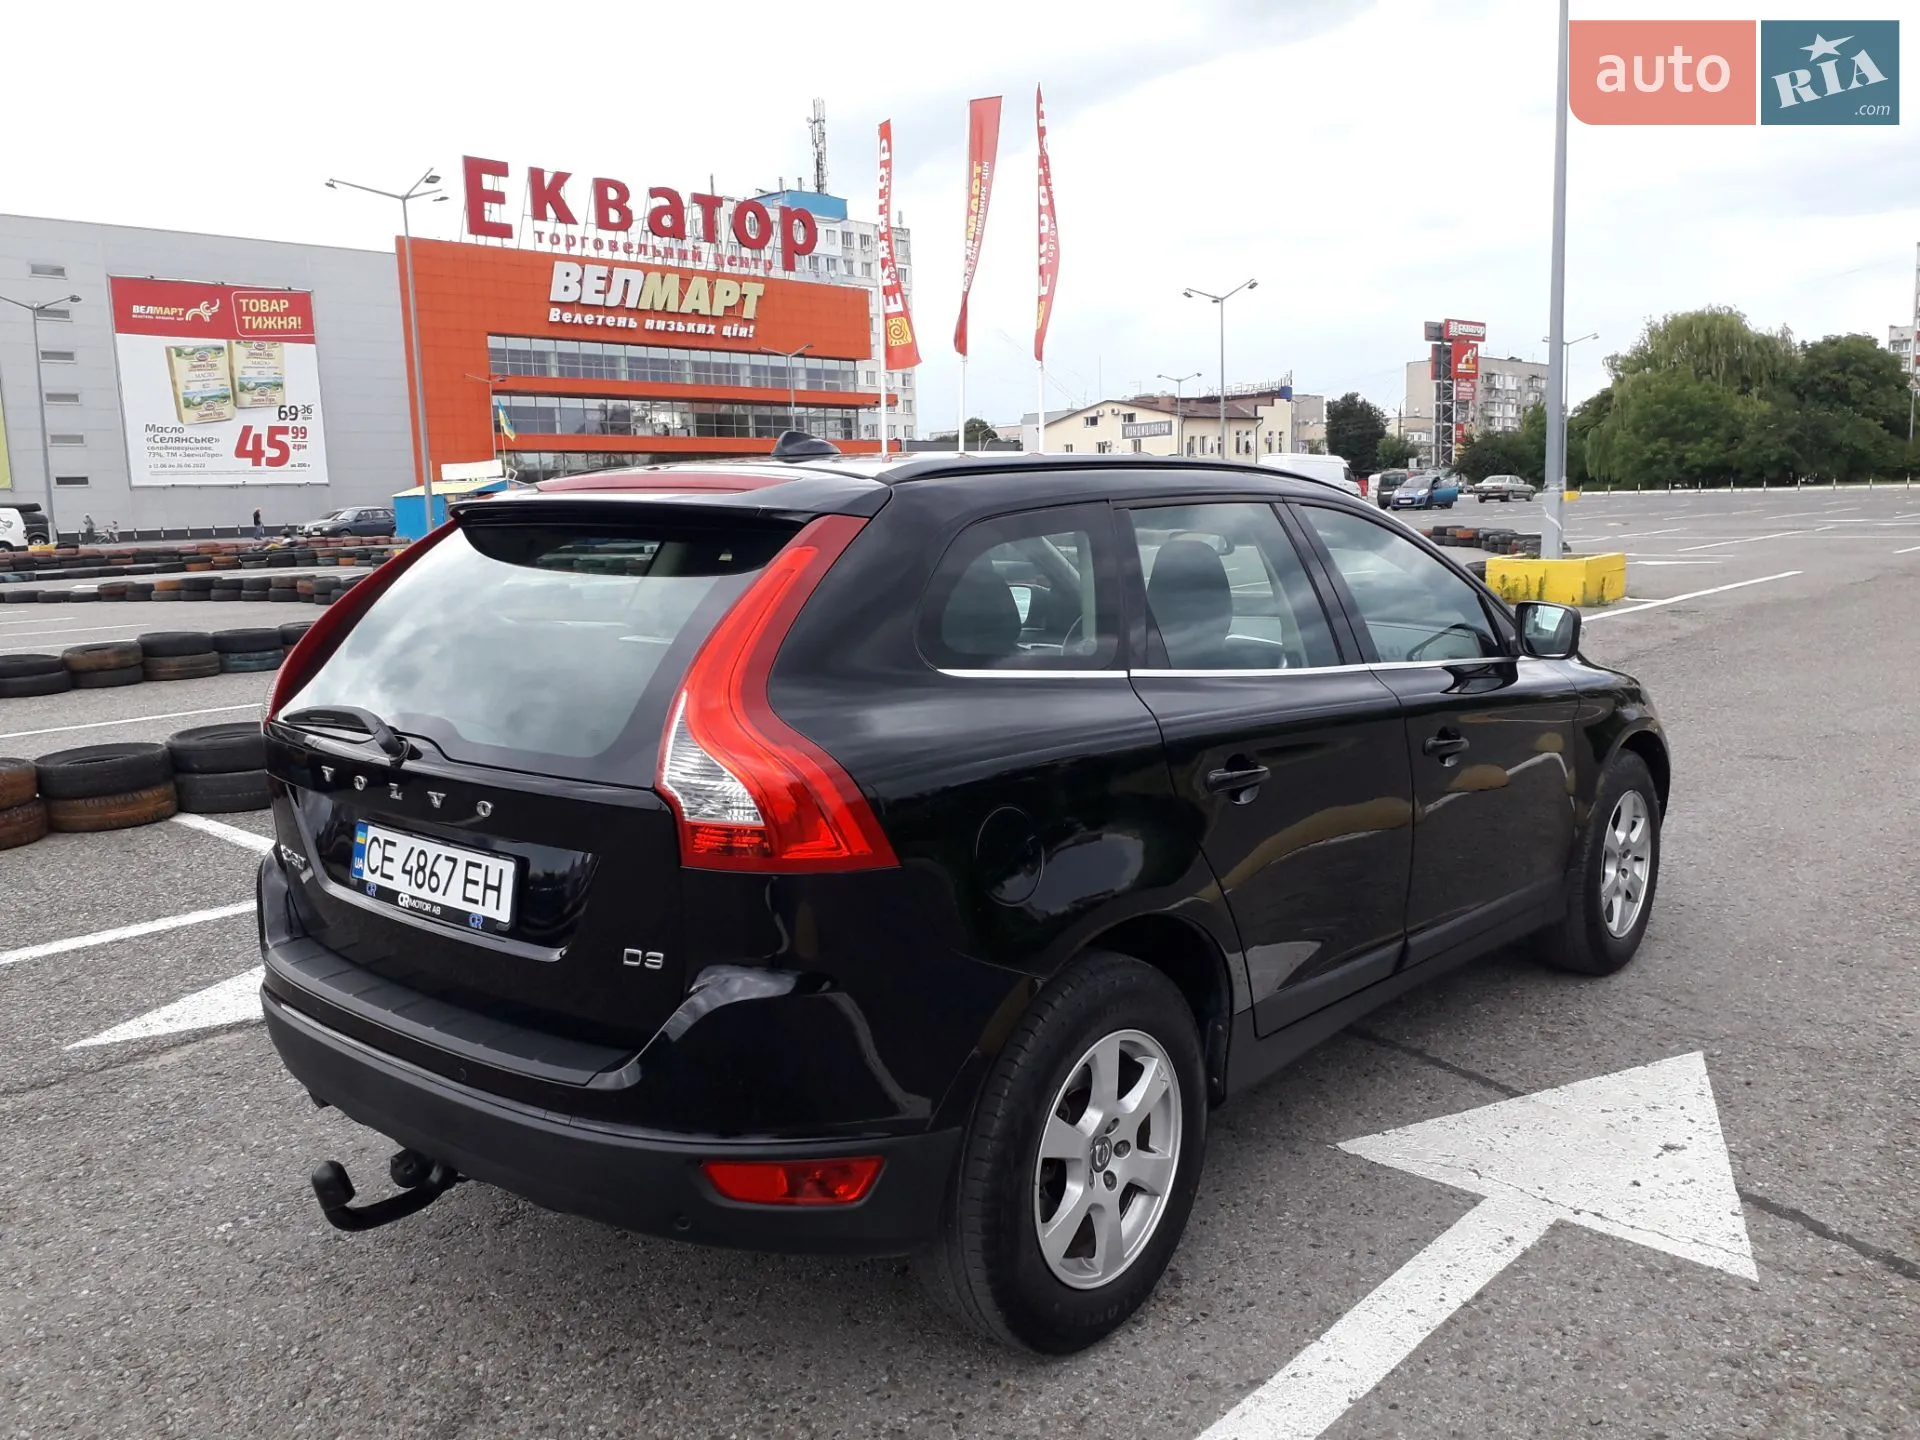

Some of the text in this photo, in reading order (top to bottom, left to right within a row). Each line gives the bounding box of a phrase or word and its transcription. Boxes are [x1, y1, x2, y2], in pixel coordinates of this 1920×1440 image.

[535, 228, 775, 275] торговельний центр
[550, 260, 765, 321] ВЕЛМАРТ
[132, 305, 185, 316] ВЕЛМАРТ
[239, 298, 289, 313] ТОВАР
[242, 316, 302, 330] ТИЖНЯ!
[549, 307, 756, 340] Велетень низьких цін!
[277, 404, 299, 421] 69
[144, 423, 185, 434] Масло
[146, 434, 220, 444] «Селянське»
[233, 424, 308, 467] 45 99
[292, 443, 308, 452] грн
[320, 765, 495, 818] VOLVO
[354, 857, 364, 870] UA
[366, 835, 504, 911] CE 4867 EH
[409, 897, 432, 912] MOTOR
[622, 947, 666, 971] D3
